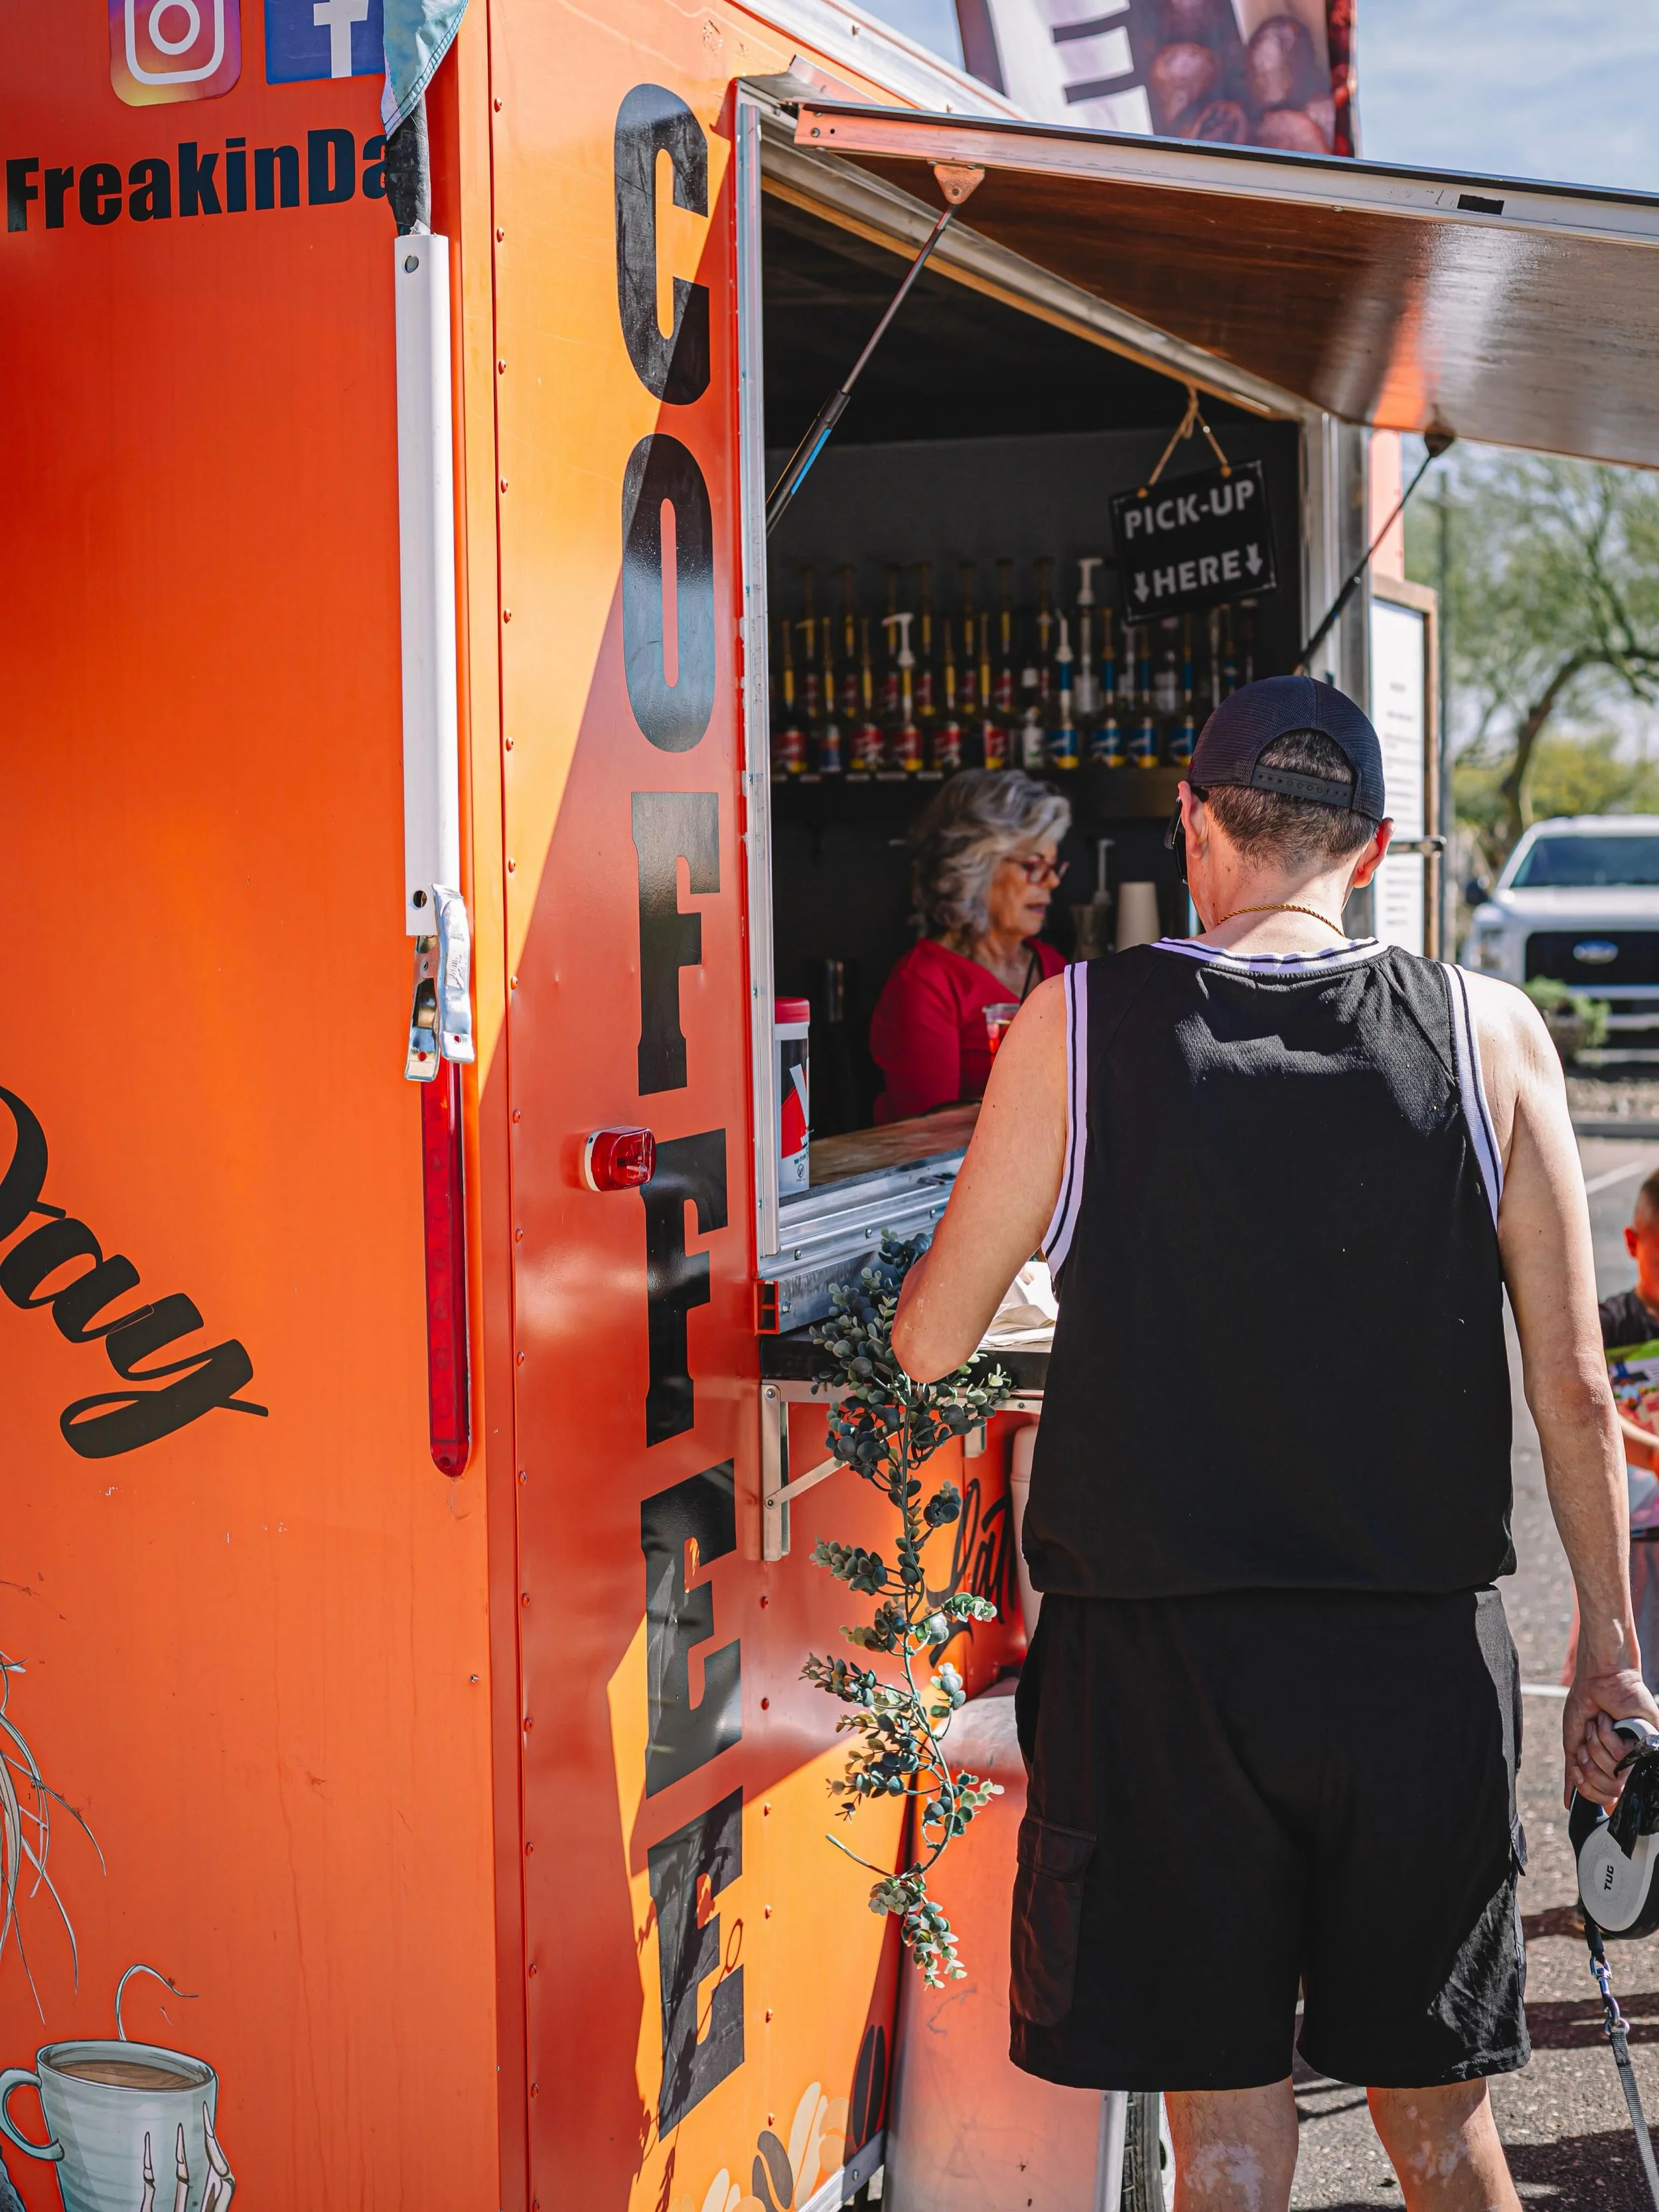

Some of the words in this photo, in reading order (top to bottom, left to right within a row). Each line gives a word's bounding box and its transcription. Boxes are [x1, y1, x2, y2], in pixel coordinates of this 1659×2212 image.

[6, 129, 388, 232] FreakinDa
[1124, 480, 1256, 539] PICK-UP
[1152, 550, 1242, 597] HERE
[614, 82, 745, 2143] COFFEE
[1604, 1865, 1614, 1890] TUG
